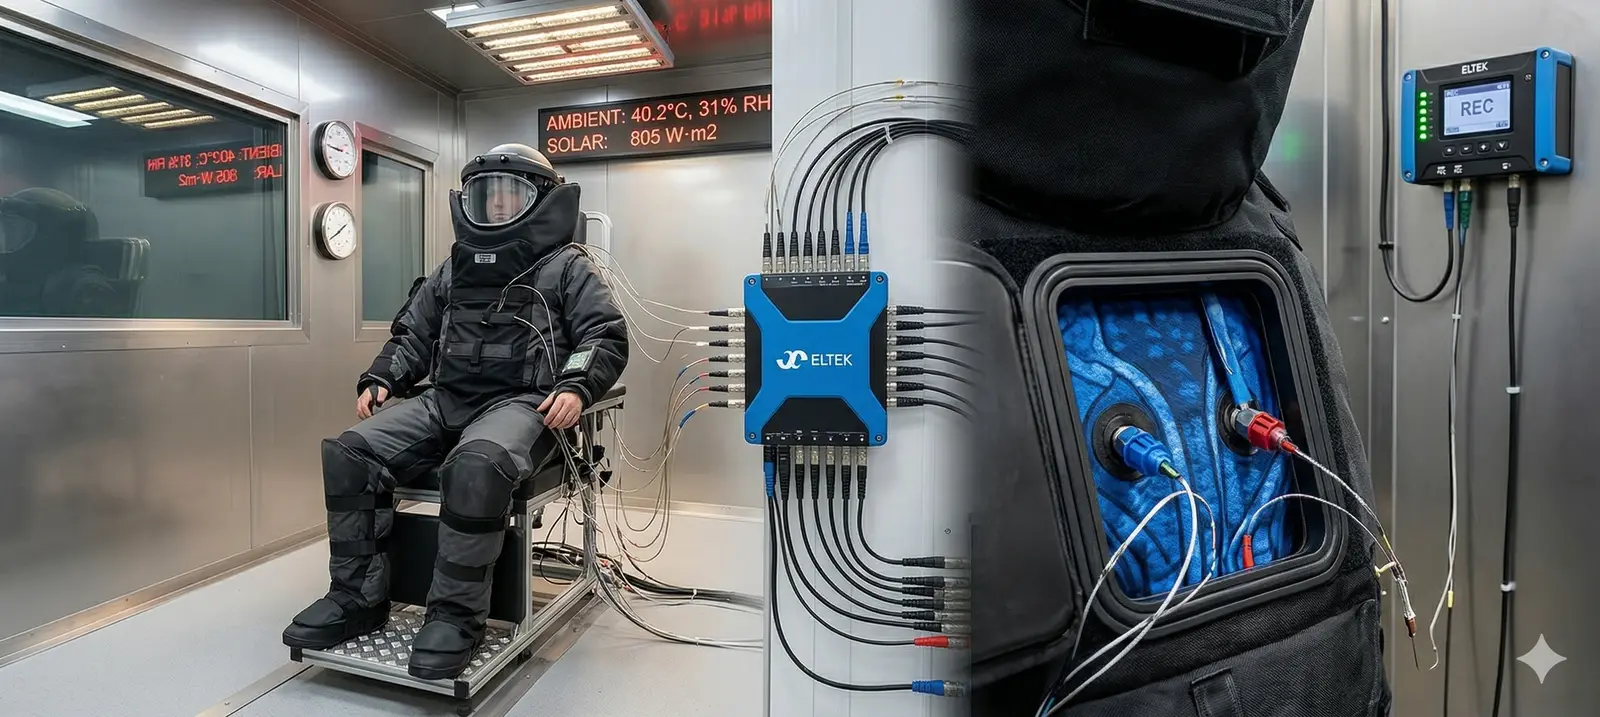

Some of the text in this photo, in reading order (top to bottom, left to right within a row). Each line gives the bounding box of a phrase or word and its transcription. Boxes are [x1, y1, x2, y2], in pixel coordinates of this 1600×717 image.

[1461, 62, 1488, 75] ELTEK
[546, 94, 771, 131] AMBIENT: 40.2°C, 31% RH
[1461, 98, 1494, 117] REC
[547, 133, 607, 154] SOLAR:
[630, 128, 660, 147] 805
[811, 353, 853, 367] ELTEK
